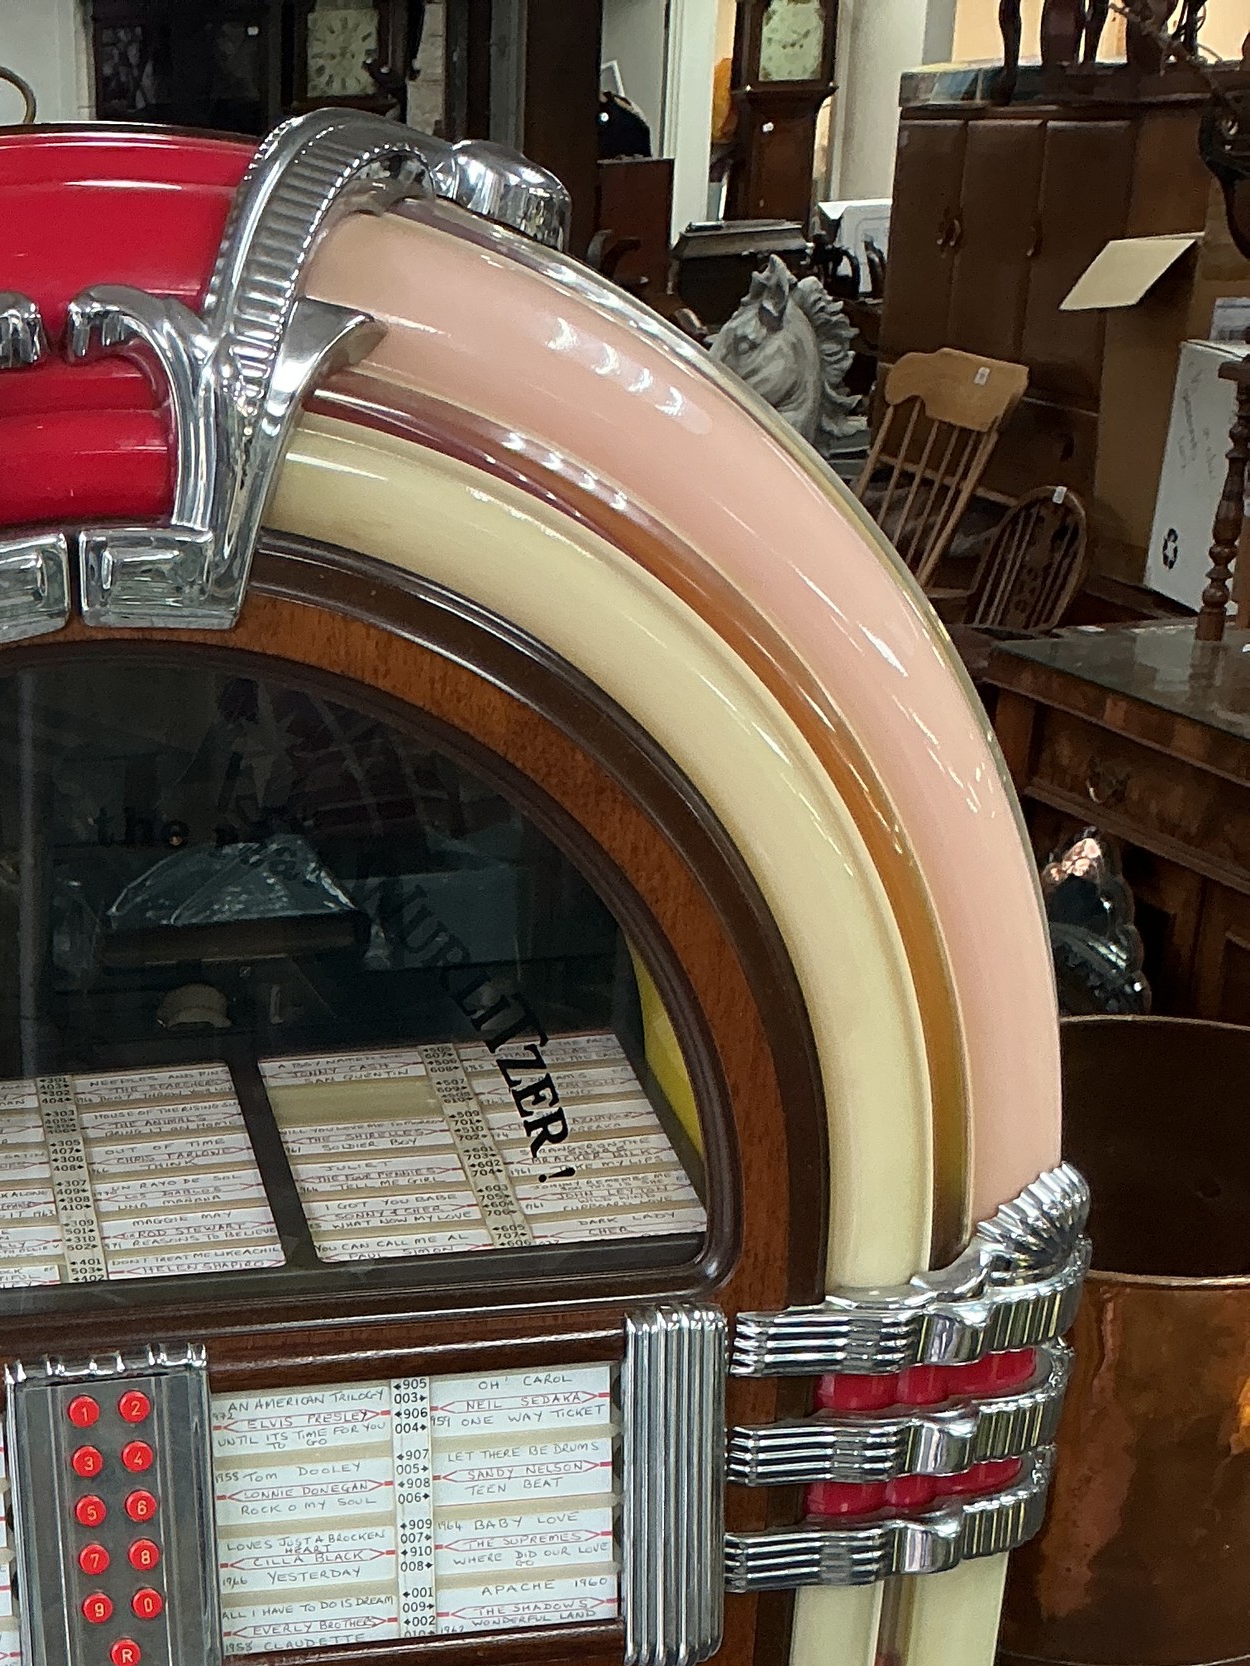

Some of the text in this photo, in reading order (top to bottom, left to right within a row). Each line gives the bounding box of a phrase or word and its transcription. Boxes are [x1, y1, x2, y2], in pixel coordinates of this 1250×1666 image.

[477, 1160, 501, 1168] 602
[471, 1169, 495, 1177] 704
[403, 1379, 427, 1389] 905
[228, 1390, 384, 1413] AN AMERICAN TRILOGY
[395, 1393, 419, 1404] 003
[467, 1392, 581, 1410] NEIL SEDAKA
[82, 1407, 88, 1422] 1
[131, 1401, 141, 1416] 2
[404, 1408, 428, 1419] 906
[248, 1409, 367, 1430] ELVIS PRESLEY
[395, 1423, 419, 1434] 004
[133, 1452, 143, 1466] 4
[406, 1450, 429, 1460] 907
[84, 1457, 93, 1471] 3
[396, 1464, 419, 1474] 005
[468, 1462, 583, 1481] SANDY NELSON
[406, 1479, 430, 1488] 908
[465, 1477, 563, 1496] TEEN BEAT
[244, 1483, 368, 1499] LONNIE DONEGAN
[398, 1494, 421, 1504] 006
[87, 1506, 97, 1520] 5
[137, 1501, 146, 1514] 6
[408, 1519, 432, 1530] 909
[475, 1512, 578, 1530] BABY LOVE
[400, 1533, 424, 1544] 007
[468, 1533, 582, 1548] THE SUPREMES
[141, 1550, 150, 1564] 8
[411, 1546, 432, 1556] 910
[90, 1554, 100, 1569] 7
[253, 1551, 364, 1567] CILLA BLACK
[401, 1561, 424, 1572] 008
[267, 1568, 361, 1585] YESTERDAY
[412, 1588, 433, 1598] 001
[482, 1578, 608, 1595] APACHE 1960
[94, 1603, 104, 1617] 9
[403, 1602, 426, 1613] 009
[413, 1616, 435, 1626] 002
[254, 1623, 312, 1637] EVERLY
[122, 1649, 132, 1663] R
